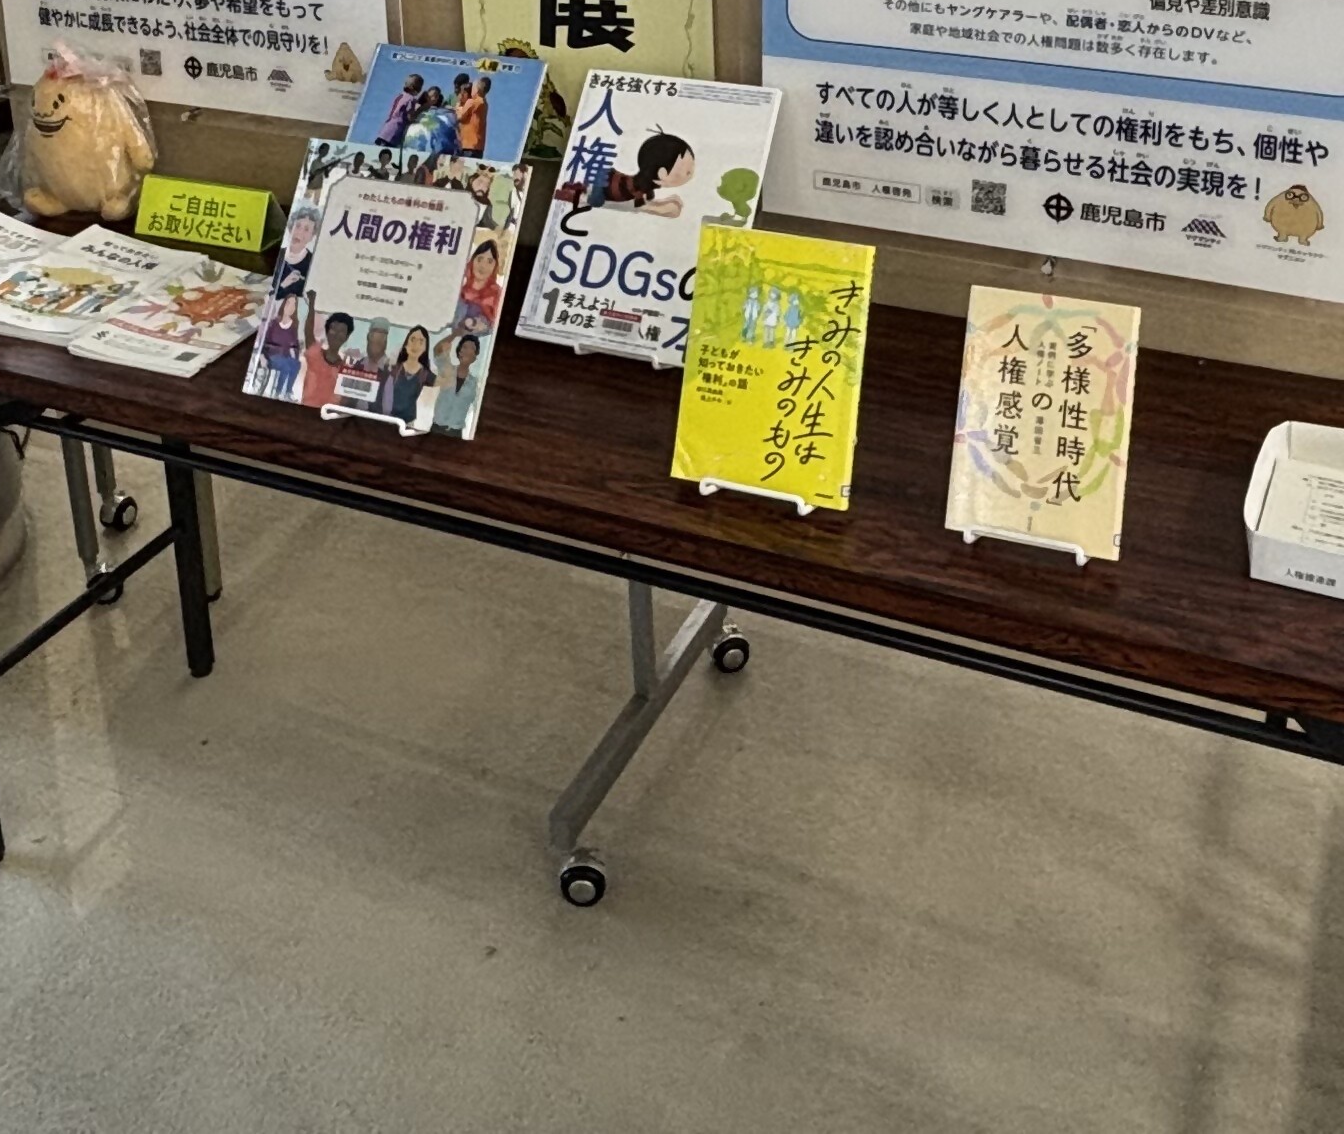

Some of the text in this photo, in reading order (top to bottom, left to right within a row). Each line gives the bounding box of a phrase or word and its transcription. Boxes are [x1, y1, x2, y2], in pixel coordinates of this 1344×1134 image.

[206, 61, 258, 82] 鹿児島市
[588, 73, 678, 97] きみを強くする
[816, 82, 1329, 166] すべての人が等しく人としての権利をもち、個性や
[815, 119, 1262, 201] 違いを認め合いながら暮らせる社会の実現を！
[169, 193, 238, 219] ご自由に
[1080, 203, 1166, 232] 鹿児島市
[148, 213, 251, 244] お取りください
[329, 209, 463, 256] 人間の権利
[543, 287, 560, 324] 1
[698, 359, 764, 376] 知っておきたい
[701, 346, 740, 359] 子どもが
[793, 280, 864, 465] きみの人生は
[991, 324, 1029, 456] 人権感覚
[761, 336, 819, 481] きみのもの
[1046, 325, 1098, 506] 「多様性時代」
